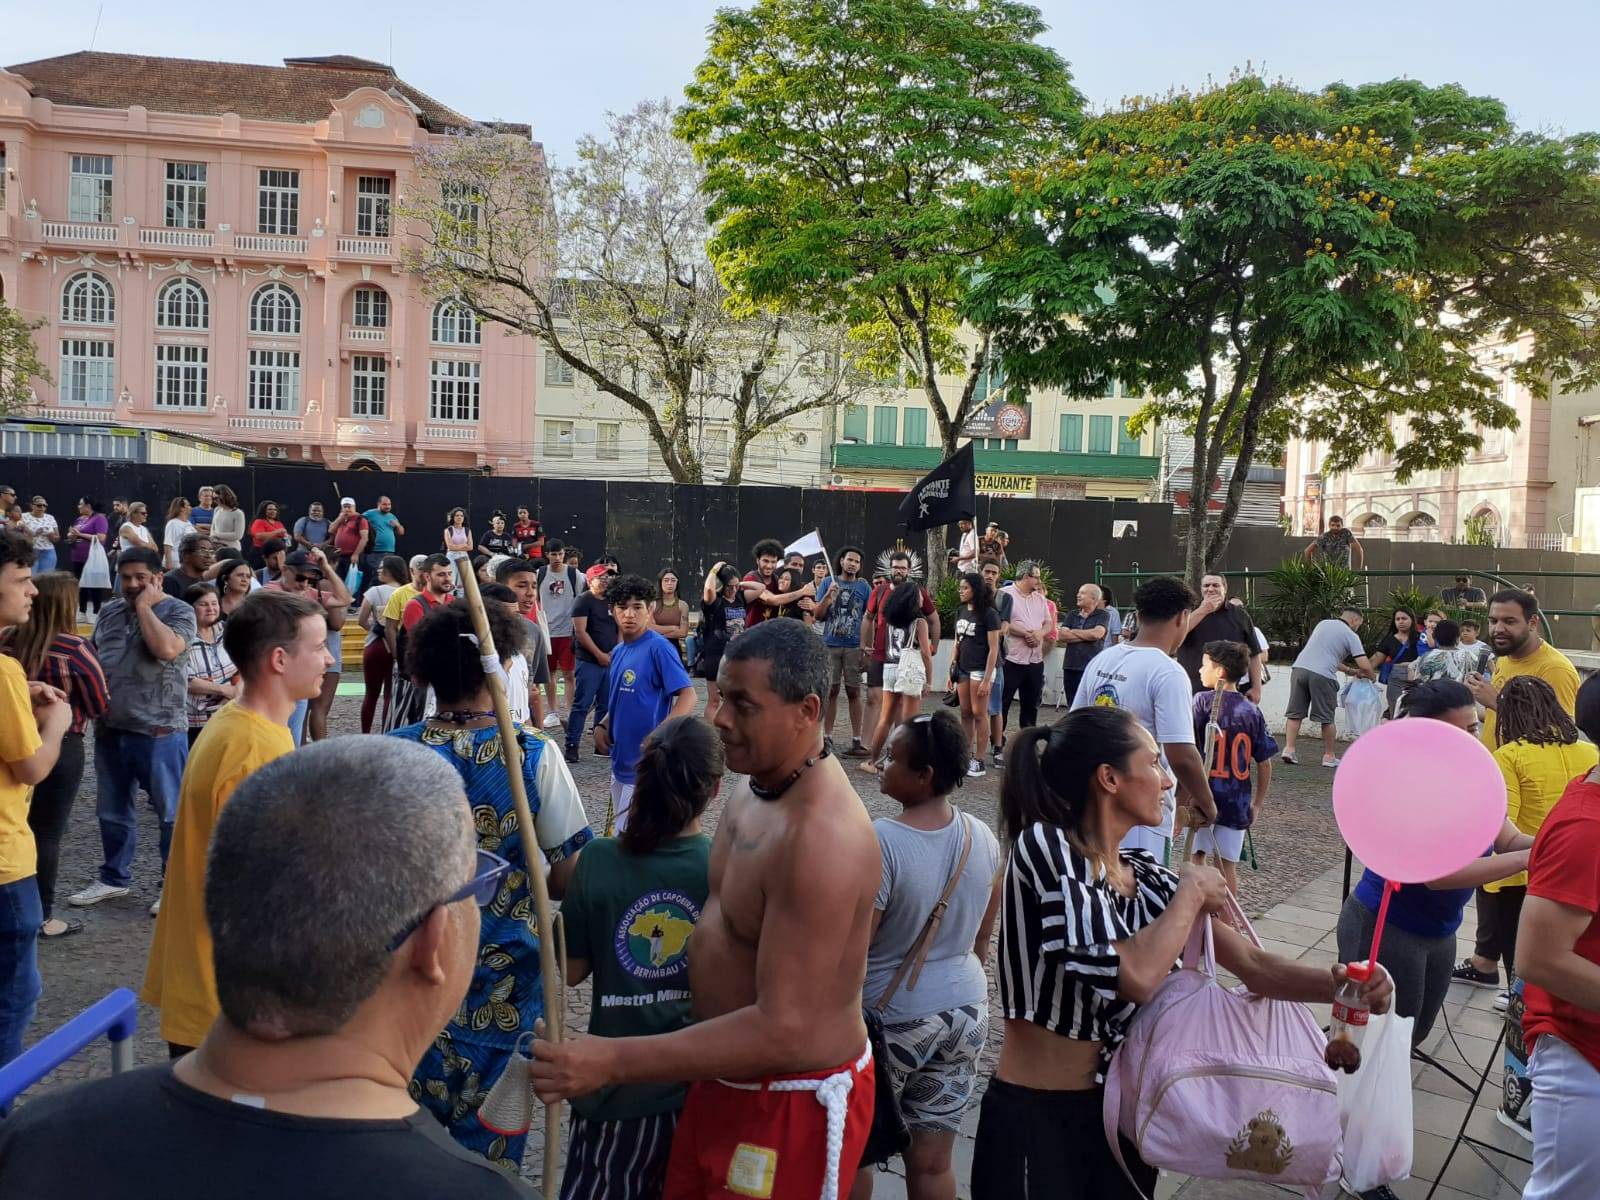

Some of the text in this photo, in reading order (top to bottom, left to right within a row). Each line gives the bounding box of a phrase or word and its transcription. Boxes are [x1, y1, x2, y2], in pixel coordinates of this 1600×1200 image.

[974, 475, 1032, 490] STAURANTE
[1209, 730, 1252, 780] 10
[618, 898, 649, 939] ASSOCIAÇÃO
[651, 893, 660, 902] DE
[662, 892, 696, 912] CAPOEIRA
[633, 965, 679, 978] BERIMBAU
